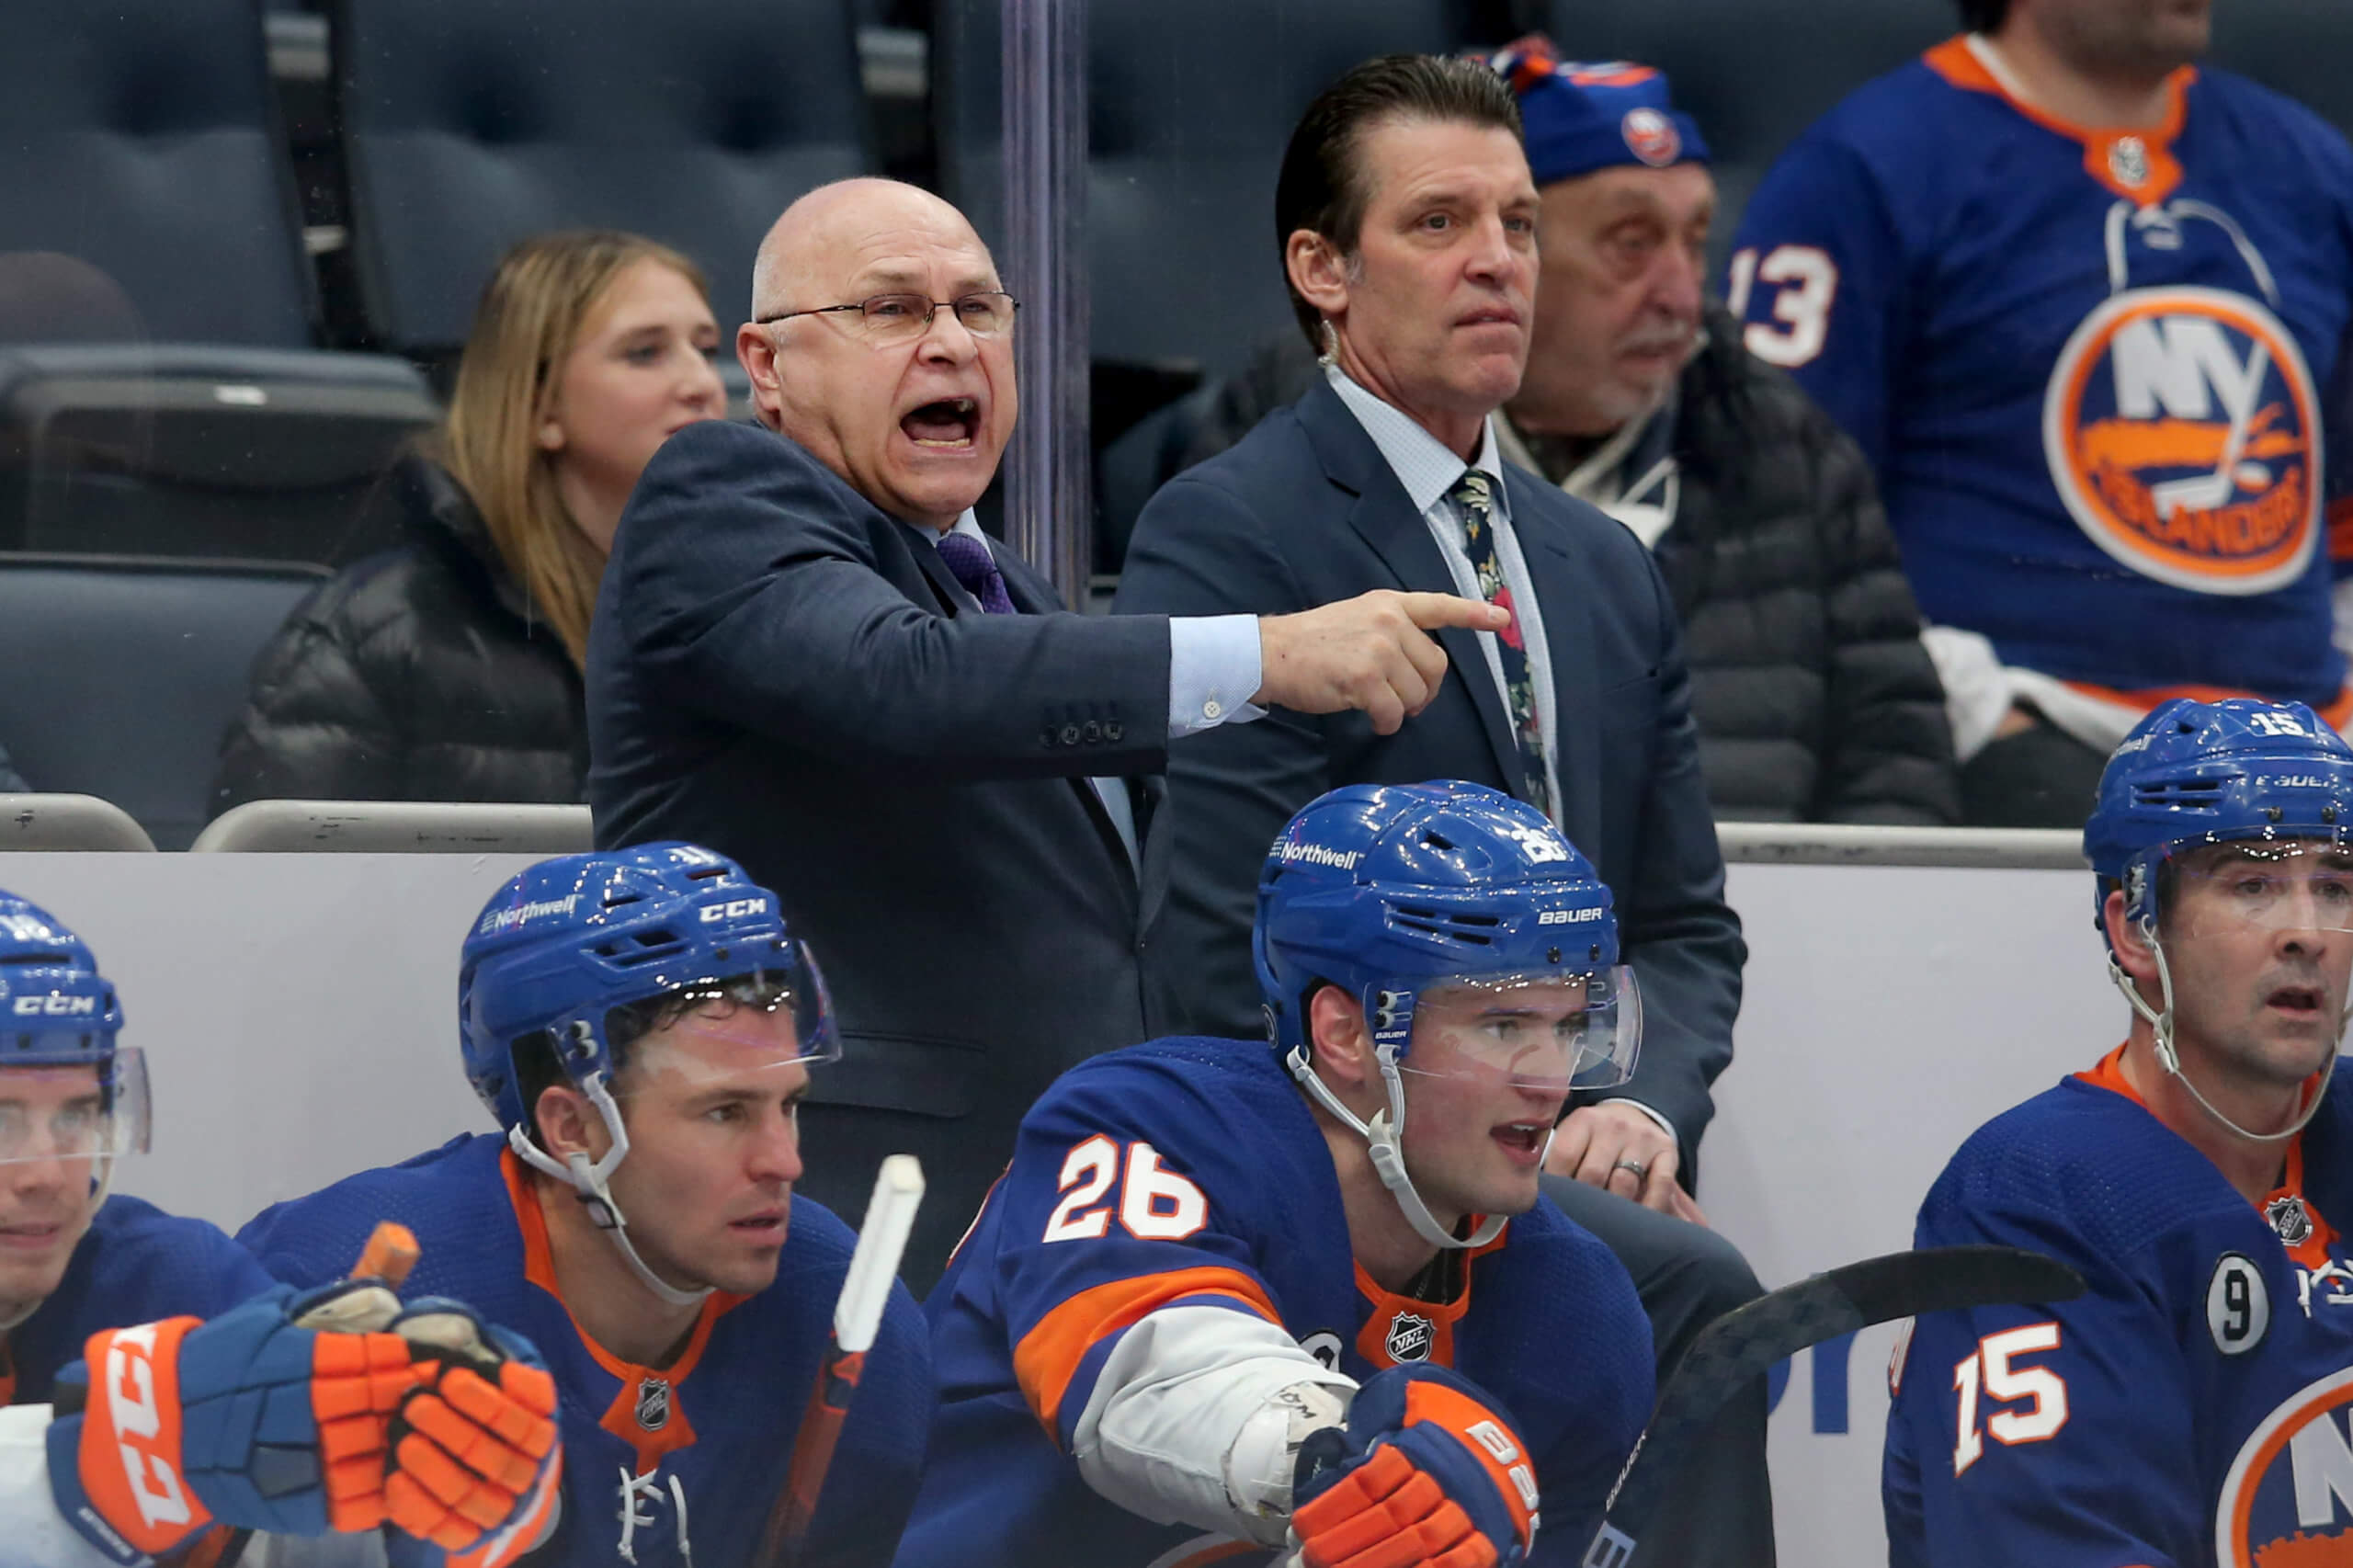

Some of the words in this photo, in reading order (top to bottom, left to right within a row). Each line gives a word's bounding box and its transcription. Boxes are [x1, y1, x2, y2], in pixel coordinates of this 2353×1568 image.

[1726, 245, 1838, 368] 13
[2109, 312, 2262, 441] NY
[2250, 711, 2305, 736] 15
[1279, 841, 1358, 870] Northwell
[494, 893, 577, 927] Northwell
[699, 897, 767, 923] CCM
[13, 995, 95, 1016] CCM
[1041, 1131, 1210, 1244] 26
[2223, 1268, 2250, 1343] 9
[1952, 1322, 2069, 1479] 15
